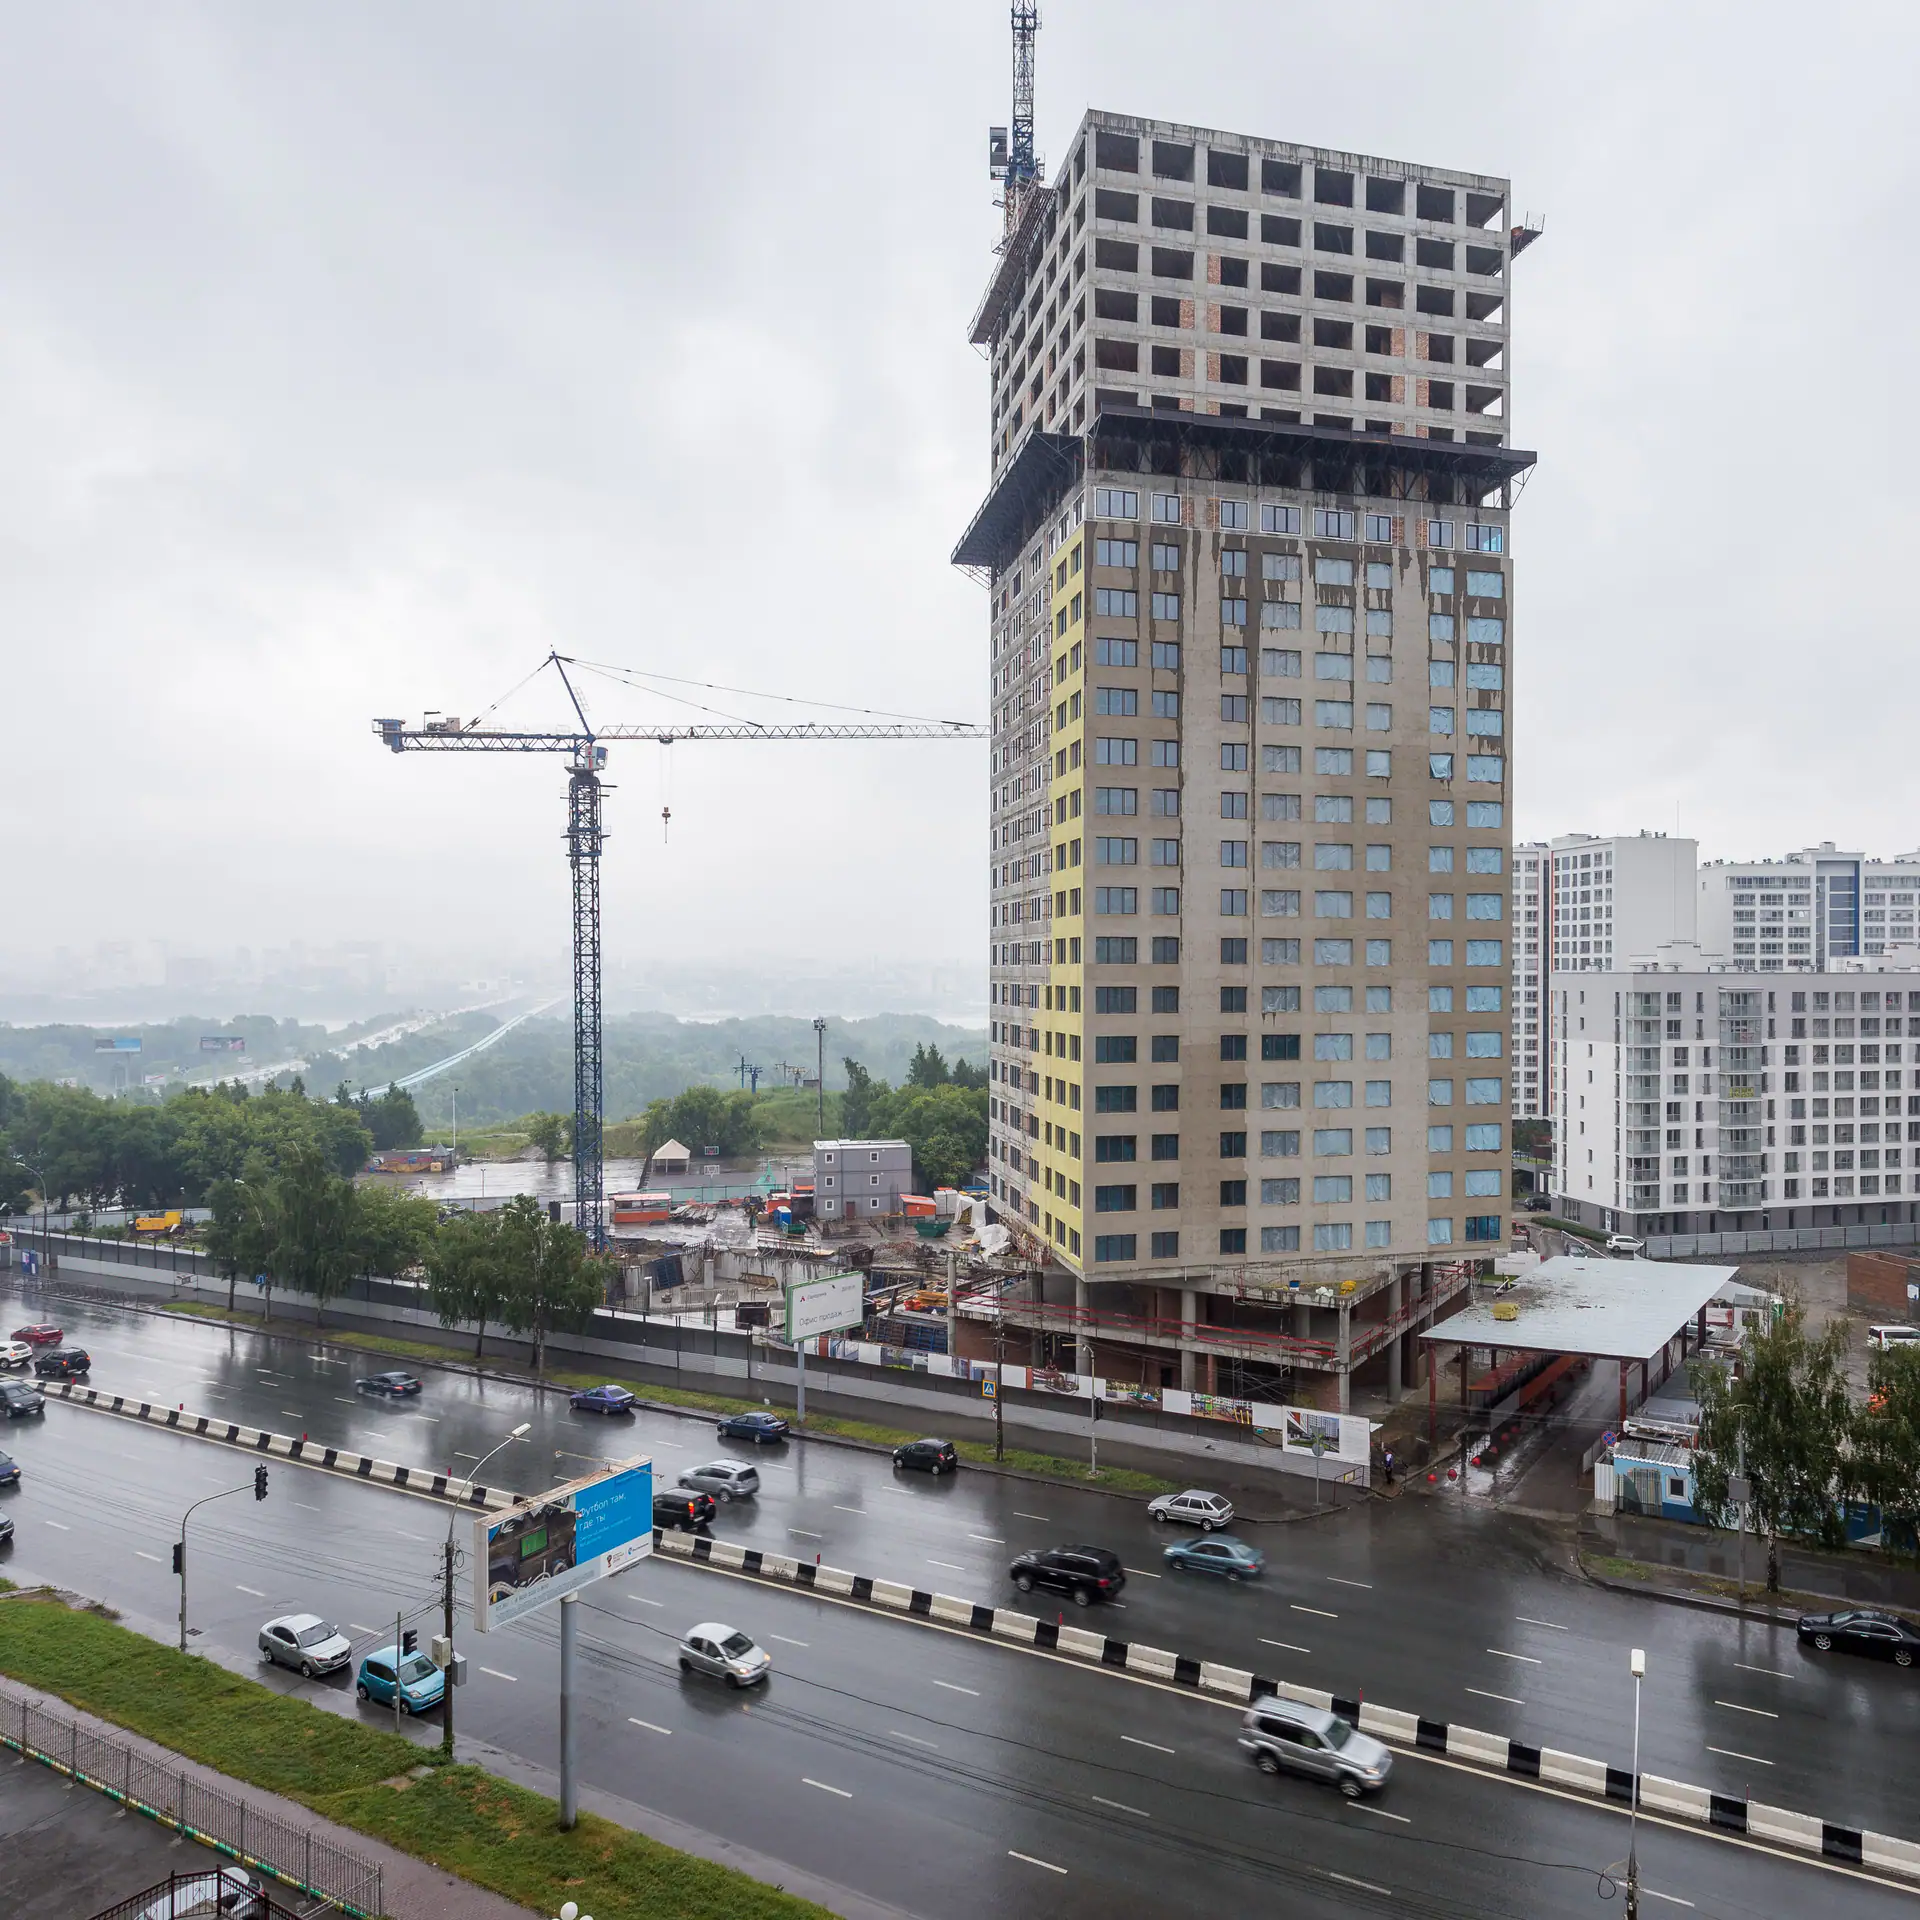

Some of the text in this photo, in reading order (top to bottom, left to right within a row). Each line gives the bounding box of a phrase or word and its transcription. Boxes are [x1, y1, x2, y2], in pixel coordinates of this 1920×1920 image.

[799, 1311, 843, 1327] Офис продаж
[579, 1518, 594, 1532] где
[596, 1514, 606, 1524] ты
